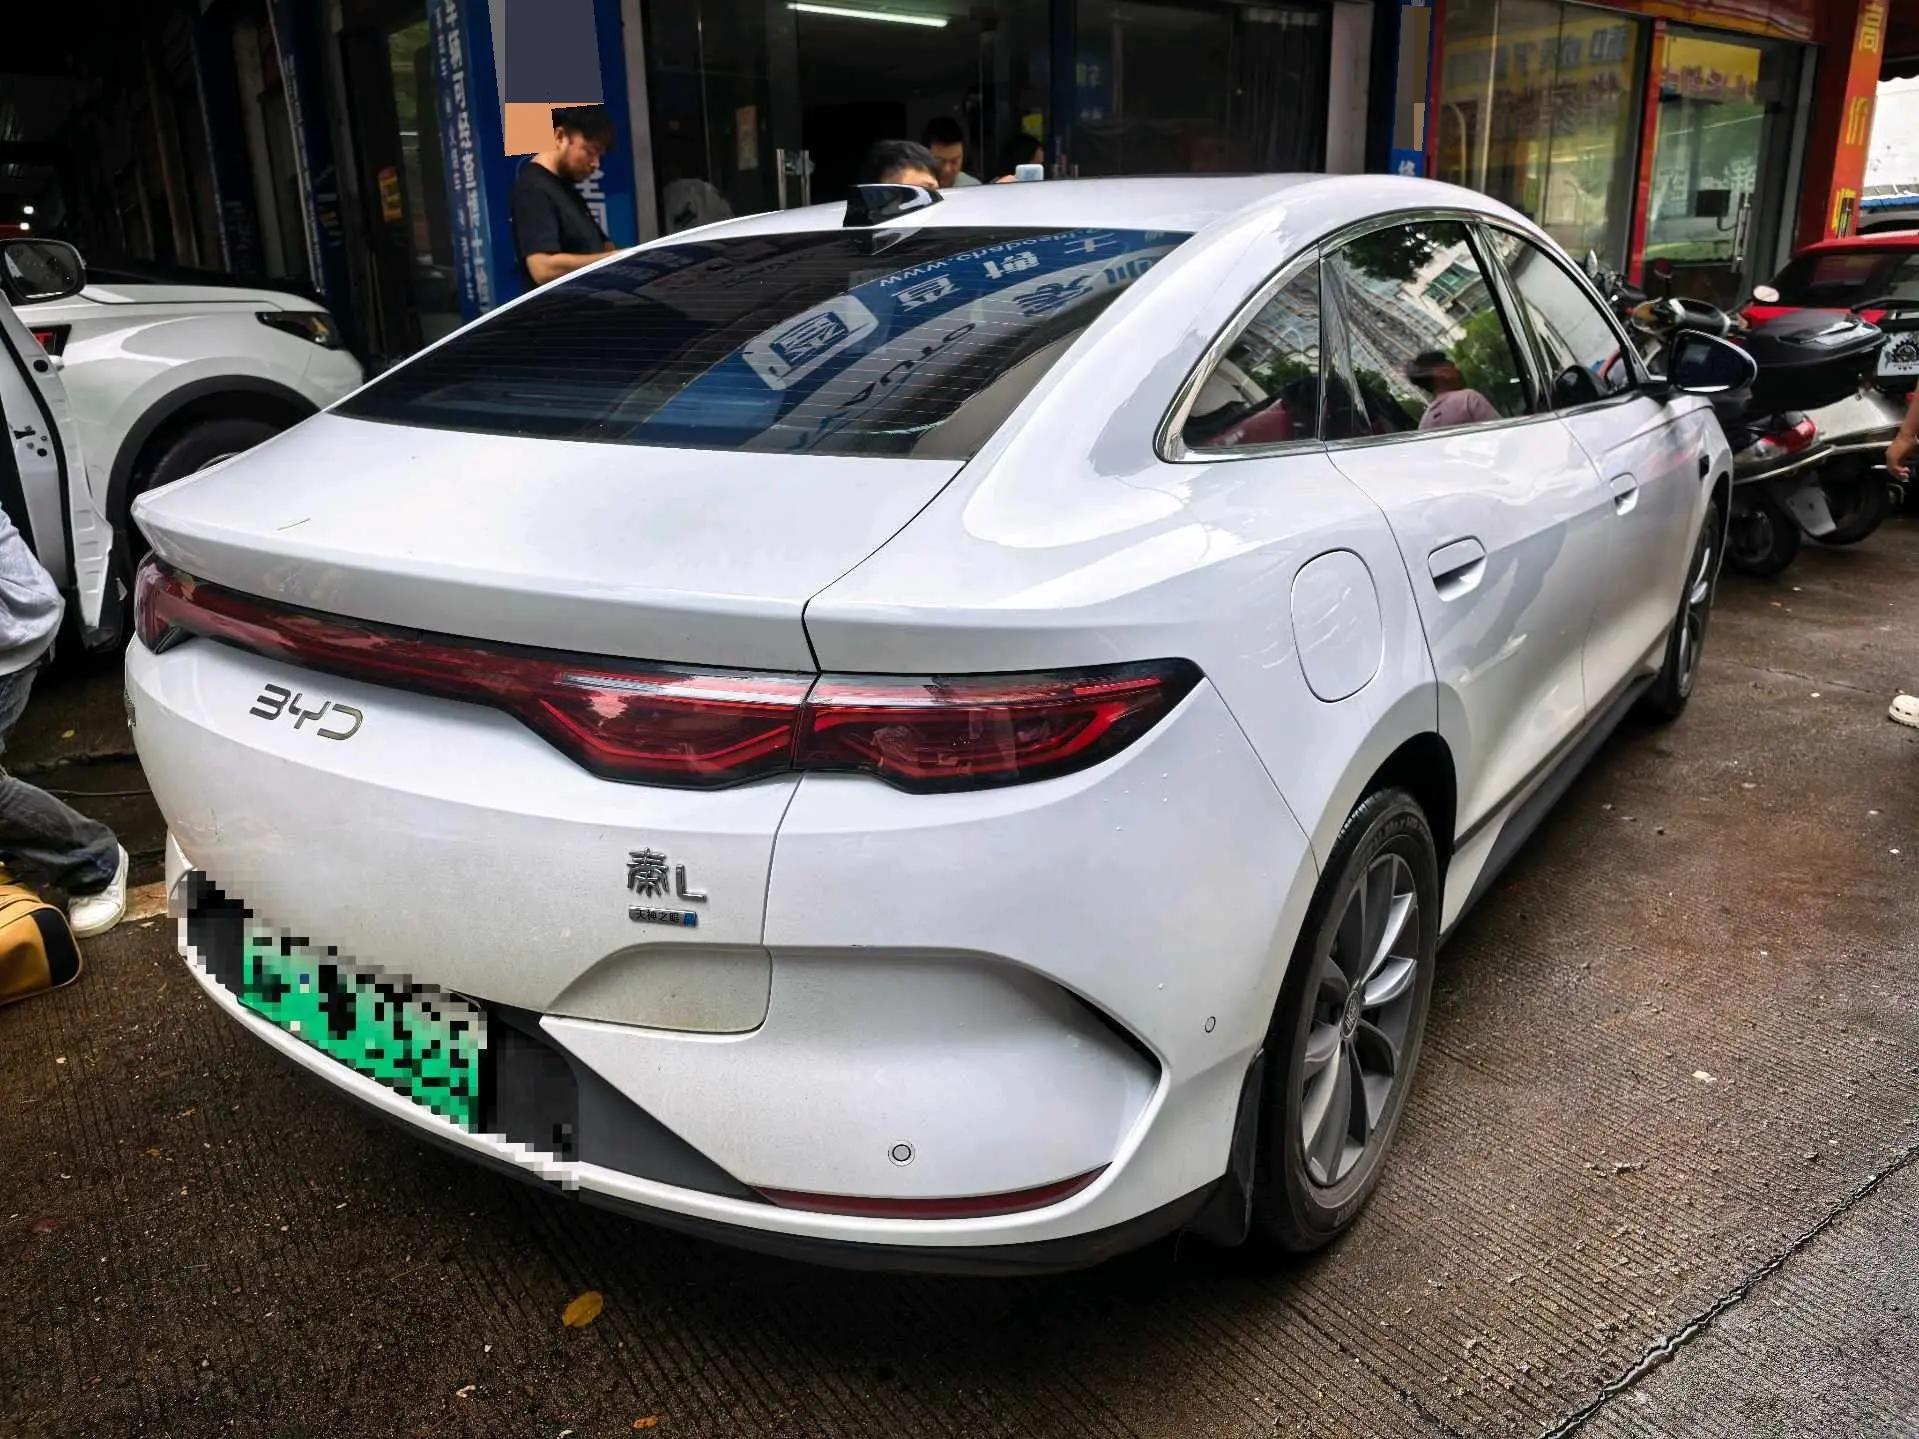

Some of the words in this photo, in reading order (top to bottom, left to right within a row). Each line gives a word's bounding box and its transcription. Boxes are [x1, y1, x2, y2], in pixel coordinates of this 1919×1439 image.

[249, 683, 365, 741] BYD
[635, 909, 681, 923] 天神之眼
